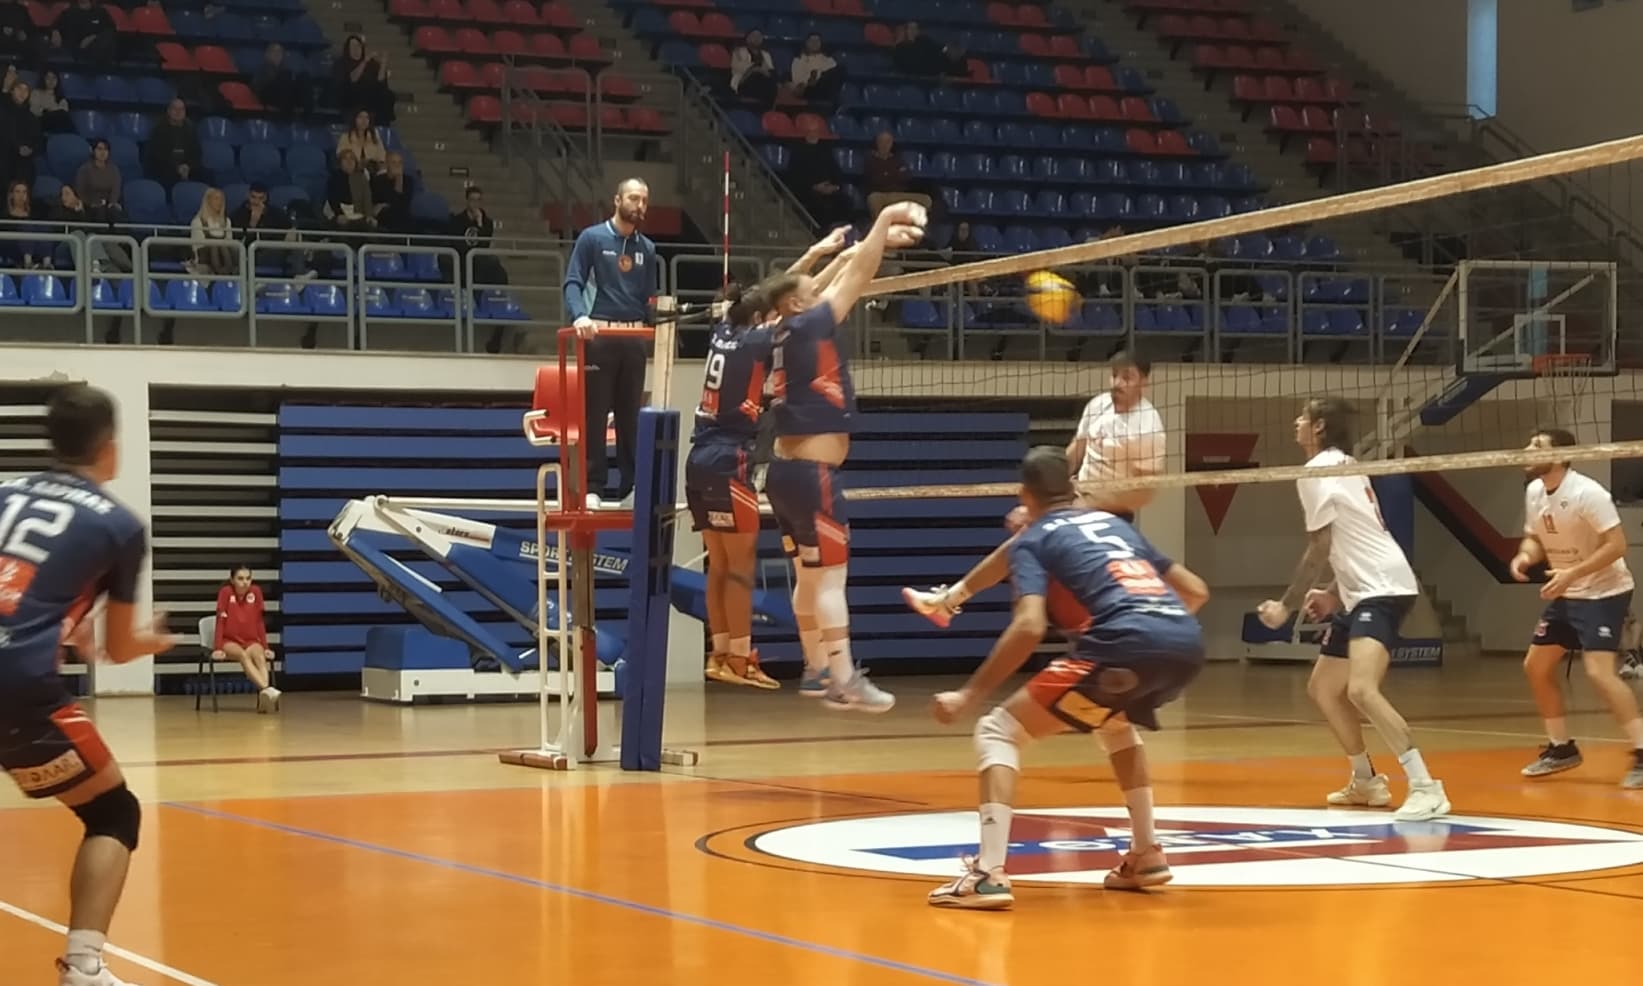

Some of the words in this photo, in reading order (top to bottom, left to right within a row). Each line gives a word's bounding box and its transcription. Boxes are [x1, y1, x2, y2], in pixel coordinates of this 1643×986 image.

[704, 349, 725, 390] 19
[0, 493, 75, 564] 12
[1078, 522, 1135, 559] 5
